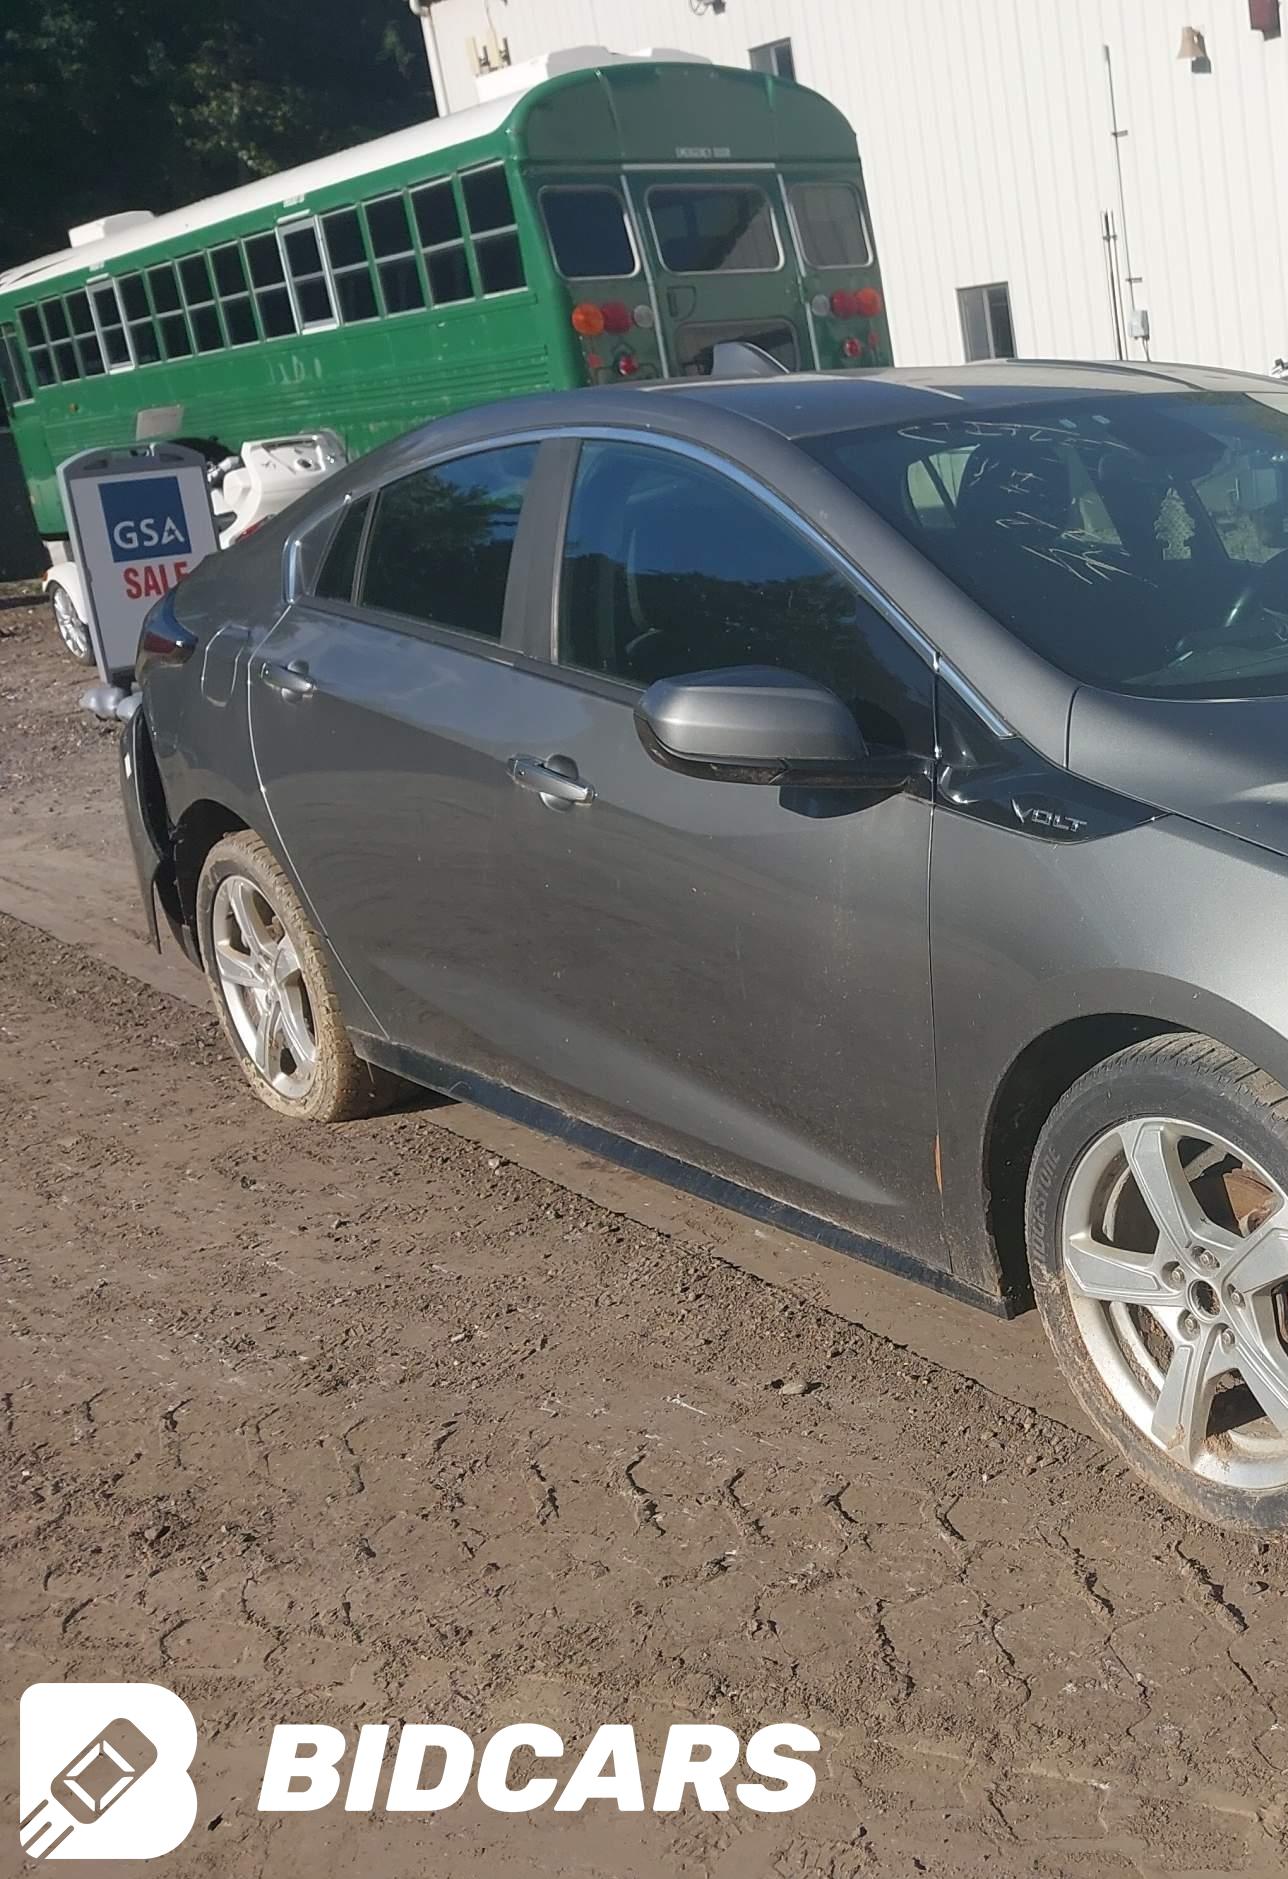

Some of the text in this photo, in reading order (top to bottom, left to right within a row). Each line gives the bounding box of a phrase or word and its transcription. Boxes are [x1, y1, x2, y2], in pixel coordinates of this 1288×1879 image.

[113, 516, 185, 549] GSA
[1011, 799, 1087, 832] VOLT
[1031, 1147, 1061, 1278] IDGESTONE
